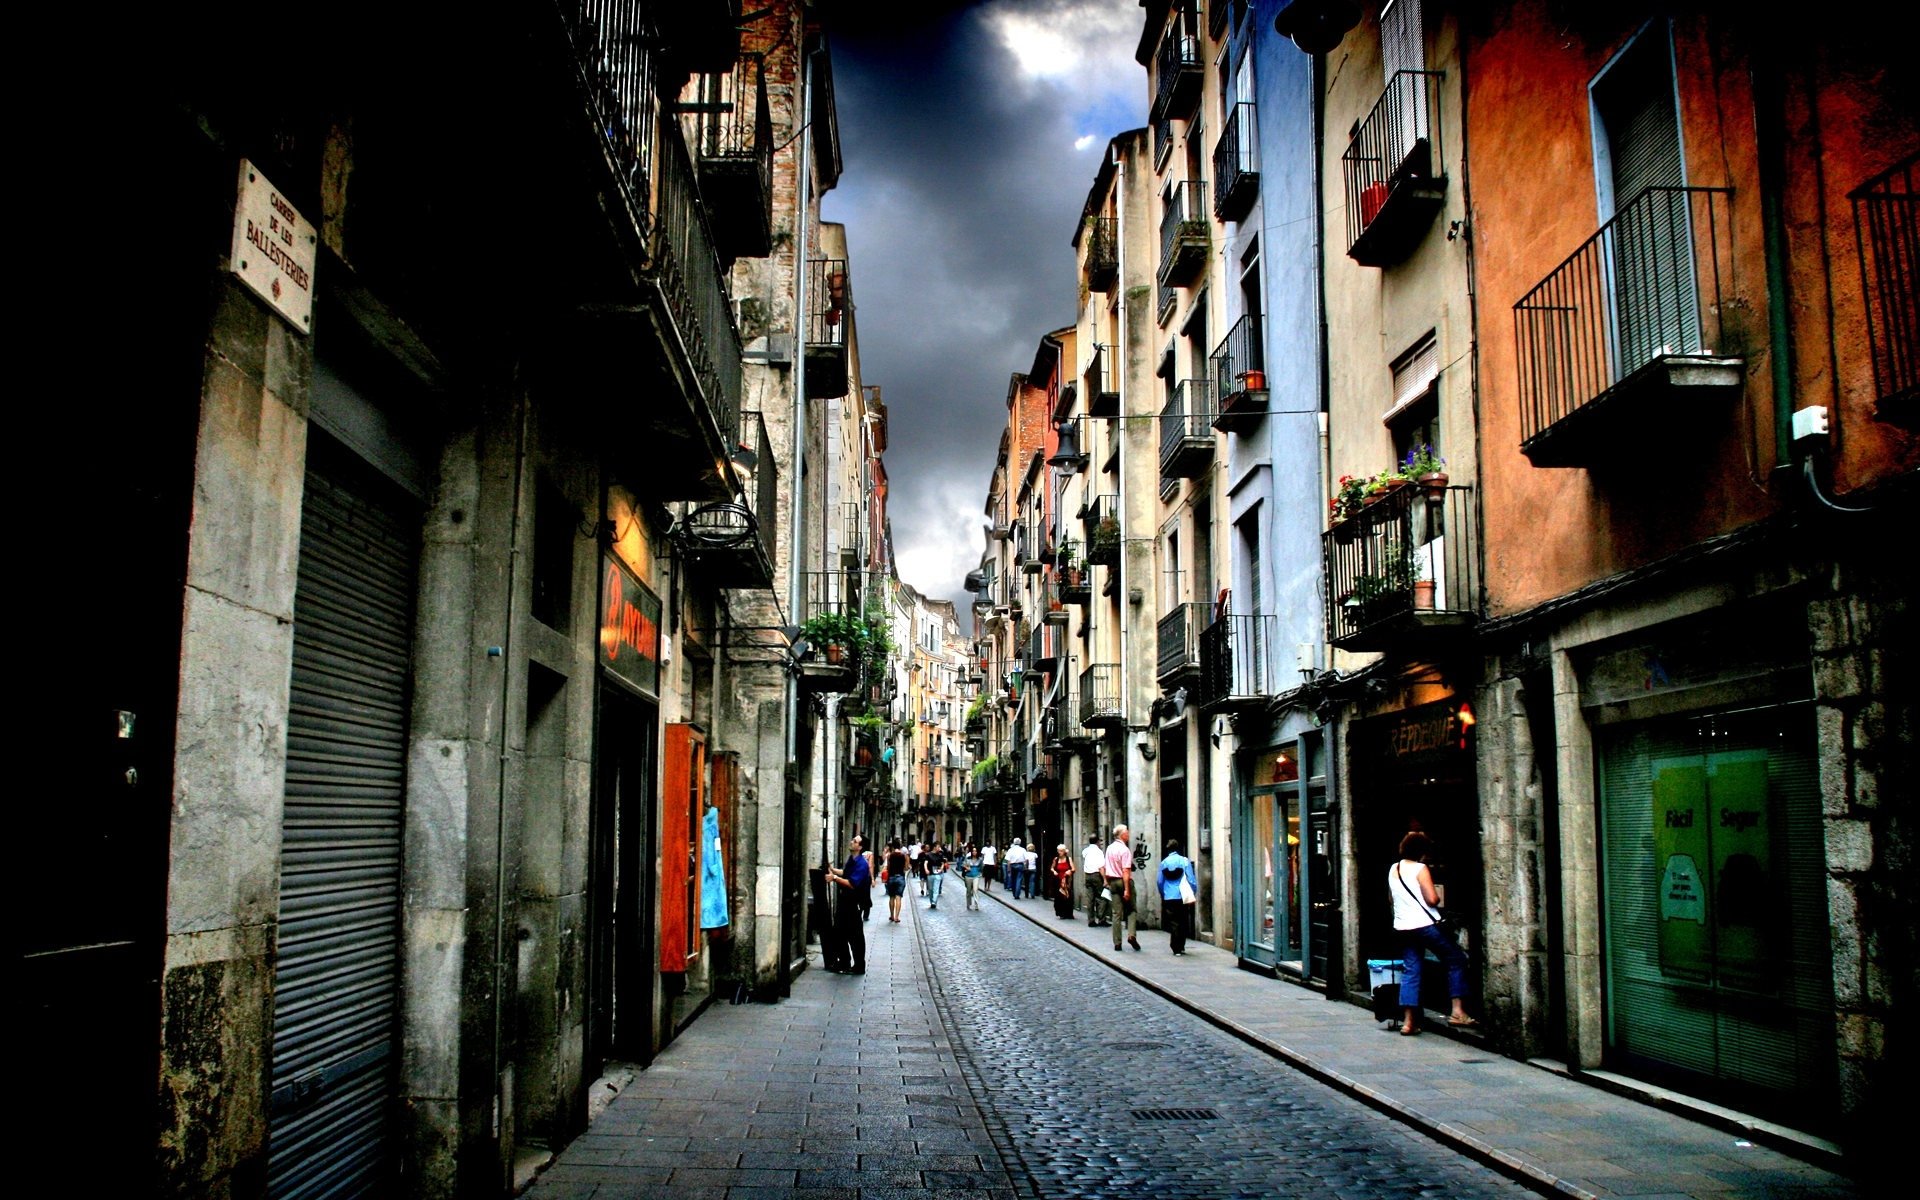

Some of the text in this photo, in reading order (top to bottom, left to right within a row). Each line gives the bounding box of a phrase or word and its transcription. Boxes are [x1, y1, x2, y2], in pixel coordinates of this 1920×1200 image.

[270, 192, 296, 227] CARRER
[269, 214, 292, 247] DE LES
[246, 218, 309, 291] BALLESTERIES
[1719, 807, 1760, 832] Segur
